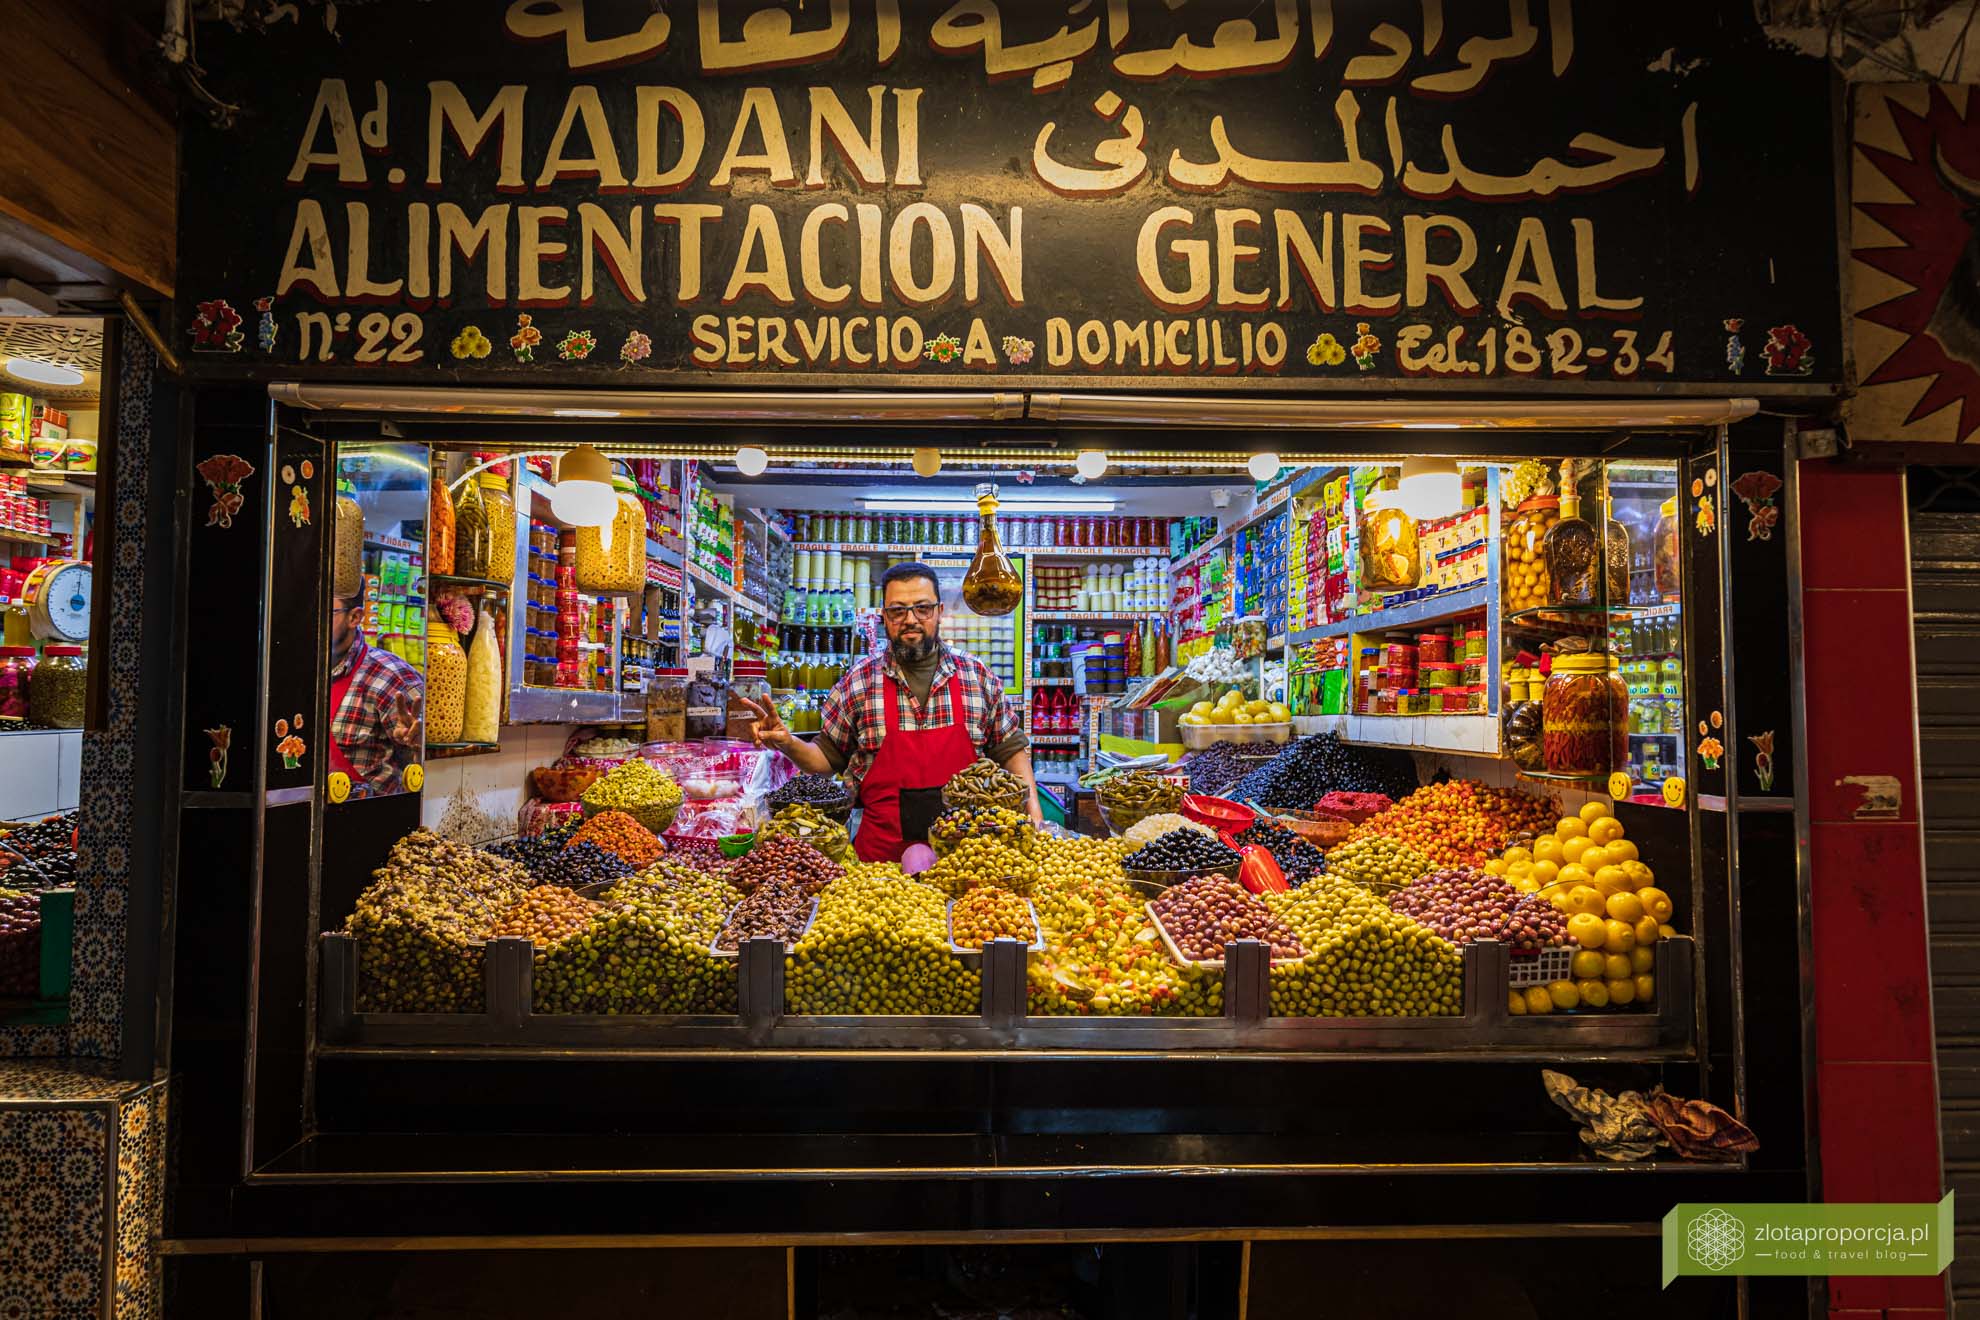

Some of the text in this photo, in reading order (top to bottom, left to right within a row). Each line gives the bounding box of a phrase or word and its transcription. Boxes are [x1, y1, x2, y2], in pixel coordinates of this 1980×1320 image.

[425, 80, 924, 190] MADANI
[276, 199, 1644, 314] ALIMENTACION GENERAL
[691, 315, 1288, 372] SERVICIO A DOMICILIO
[793, 543, 832, 551] FRAGILE
[840, 544, 878, 552] FRAGILE
[1065, 546, 1103, 554] FRAGILE
[1112, 546, 1150, 554] FRAGILE
[1065, 612, 1103, 620] FRAGILE
[1033, 736, 1073, 744] FRAGILE
